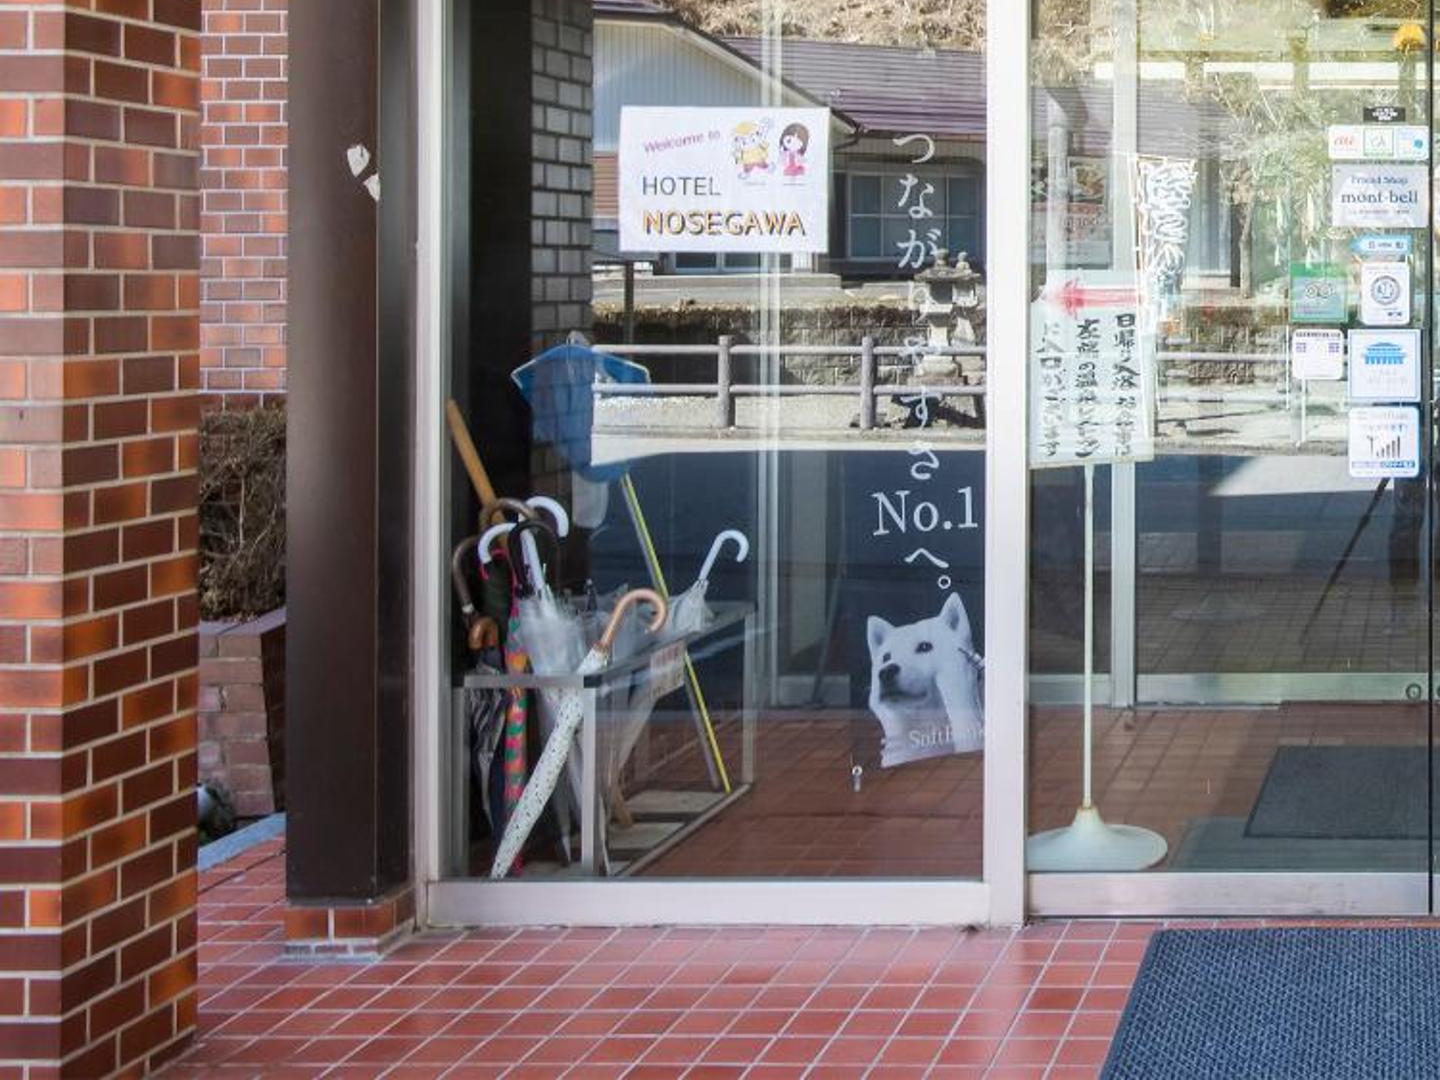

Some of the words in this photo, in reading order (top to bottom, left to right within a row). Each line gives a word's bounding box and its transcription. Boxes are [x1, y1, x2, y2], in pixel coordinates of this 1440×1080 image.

[642, 176, 721, 197] HOTEL
[643, 210, 807, 237] NOSEGAWA
[870, 485, 979, 537] No.1
